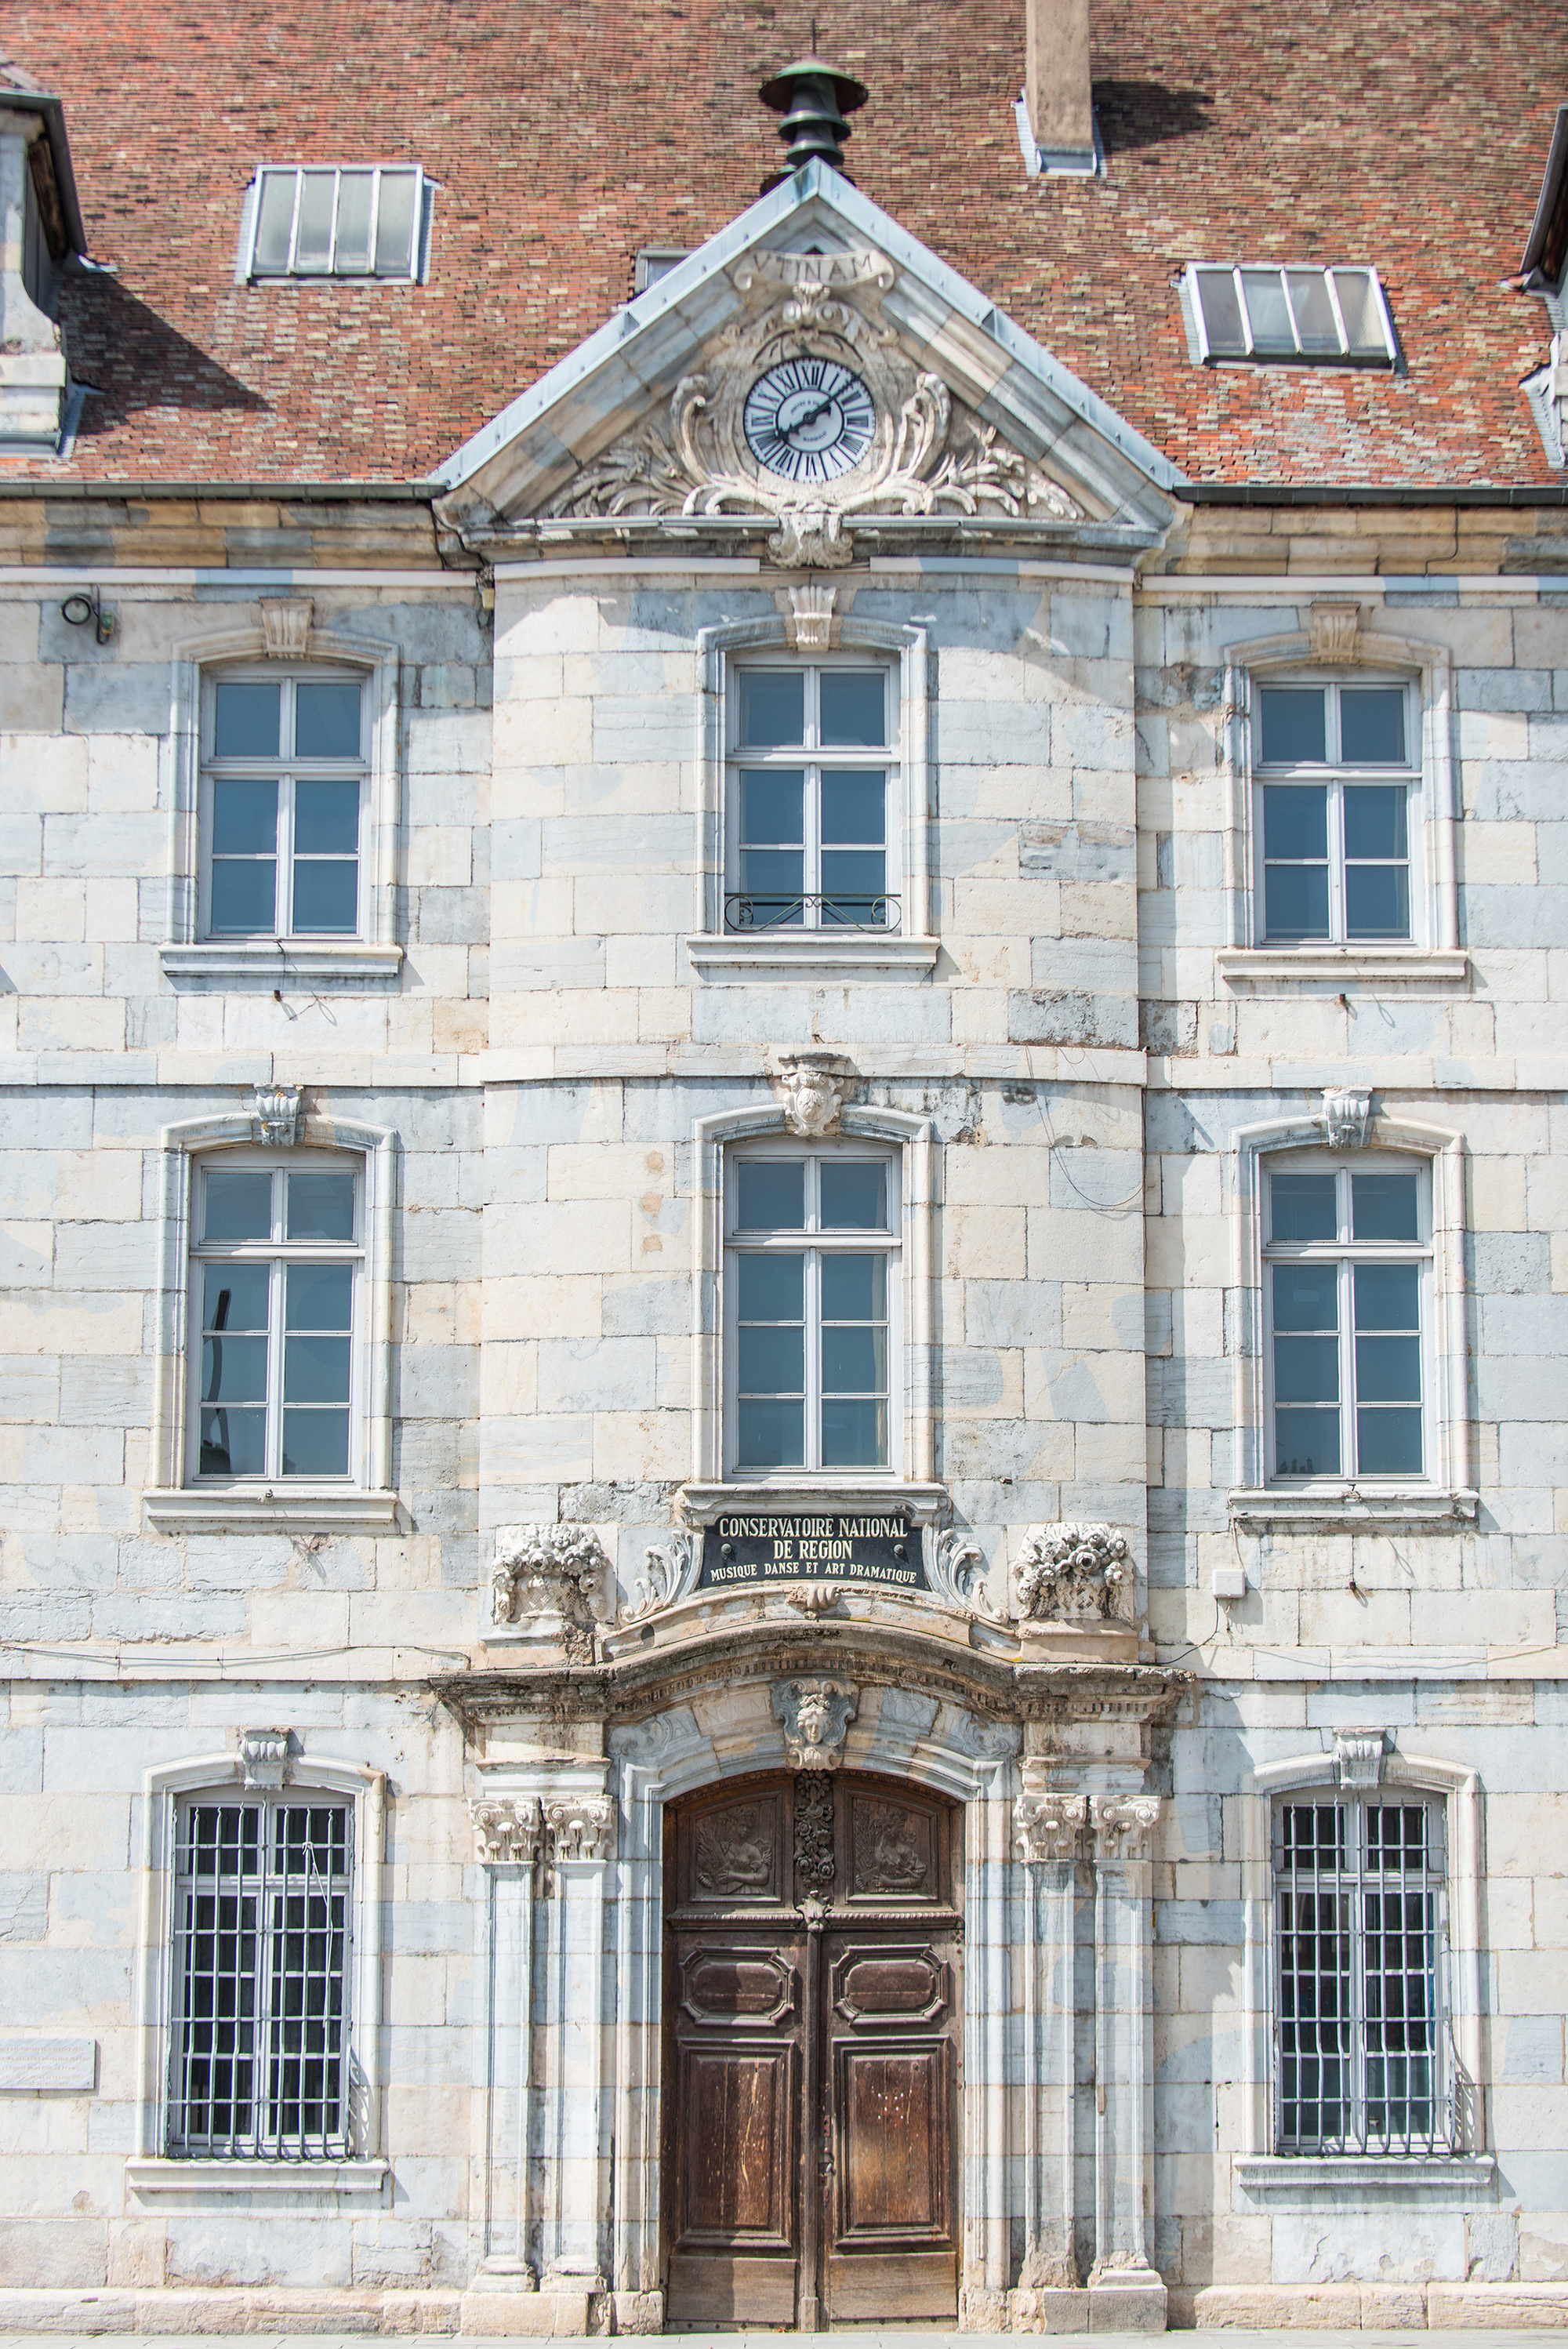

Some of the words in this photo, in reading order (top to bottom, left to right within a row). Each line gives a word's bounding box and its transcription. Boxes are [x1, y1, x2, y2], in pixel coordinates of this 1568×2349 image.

[753, 253, 873, 281] VTINAM
[776, 369, 795, 394] XI
[801, 364, 820, 386] XII
[829, 371, 840, 390] I
[758, 389, 780, 408] X
[841, 390, 861, 405] II
[751, 414, 774, 427] IX
[847, 416, 869, 427] III
[775, 448, 795, 472] VII
[805, 455, 817, 476] VI
[829, 449, 842, 470] V
[720, 1518, 834, 1537] CONSERVATOIRE
[838, 1518, 908, 1537] NATIONAL
[773, 1540, 793, 1559] DE
[799, 1540, 852, 1559] REGION
[710, 1563, 757, 1581] MUSIQUE
[764, 1562, 799, 1575] DANSE
[806, 1562, 818, 1574] ET
[825, 1562, 845, 1574] ART
[849, 1563, 916, 1584] DRAMATIQUE
